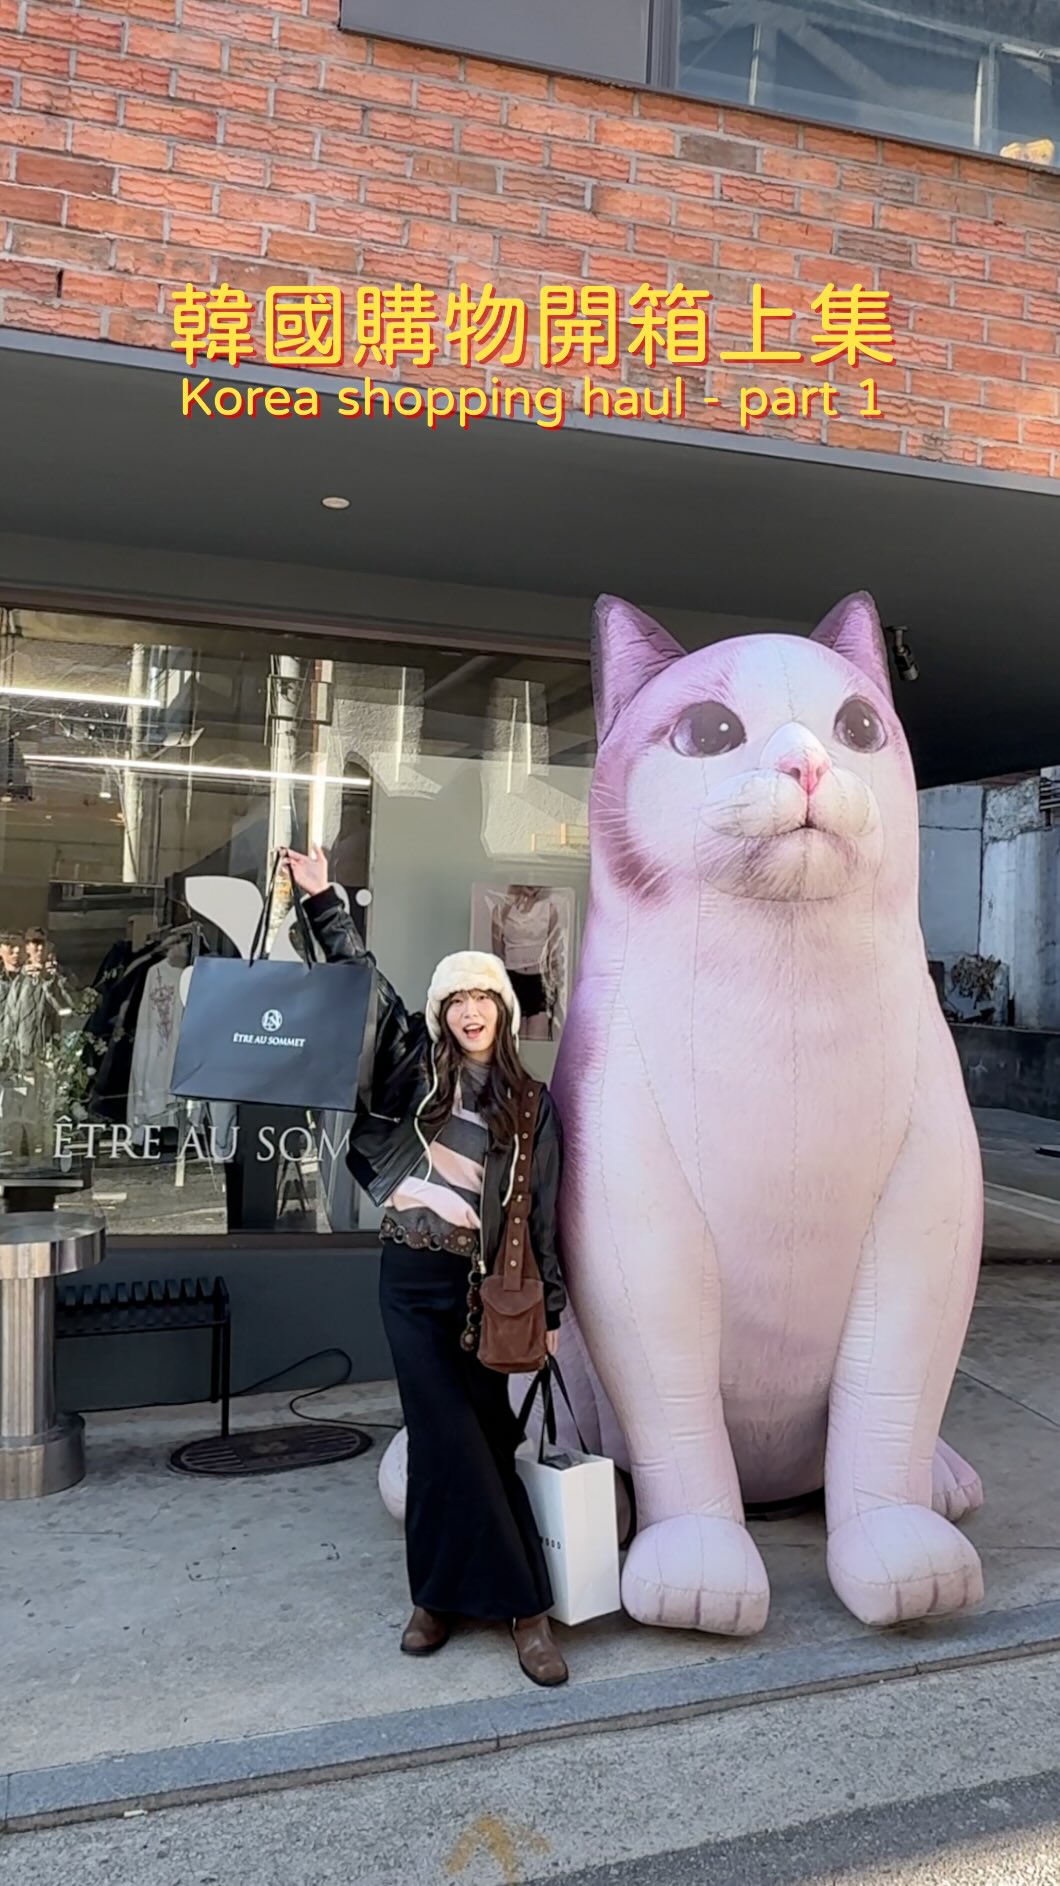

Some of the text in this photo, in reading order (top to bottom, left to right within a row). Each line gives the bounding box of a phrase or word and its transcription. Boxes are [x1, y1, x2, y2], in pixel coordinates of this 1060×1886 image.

[254, 1035, 267, 1045] AU
[267, 1037, 306, 1047] SOMMET
[52, 1115, 161, 1159] ÊTRE
[176, 1125, 241, 1161] AU
